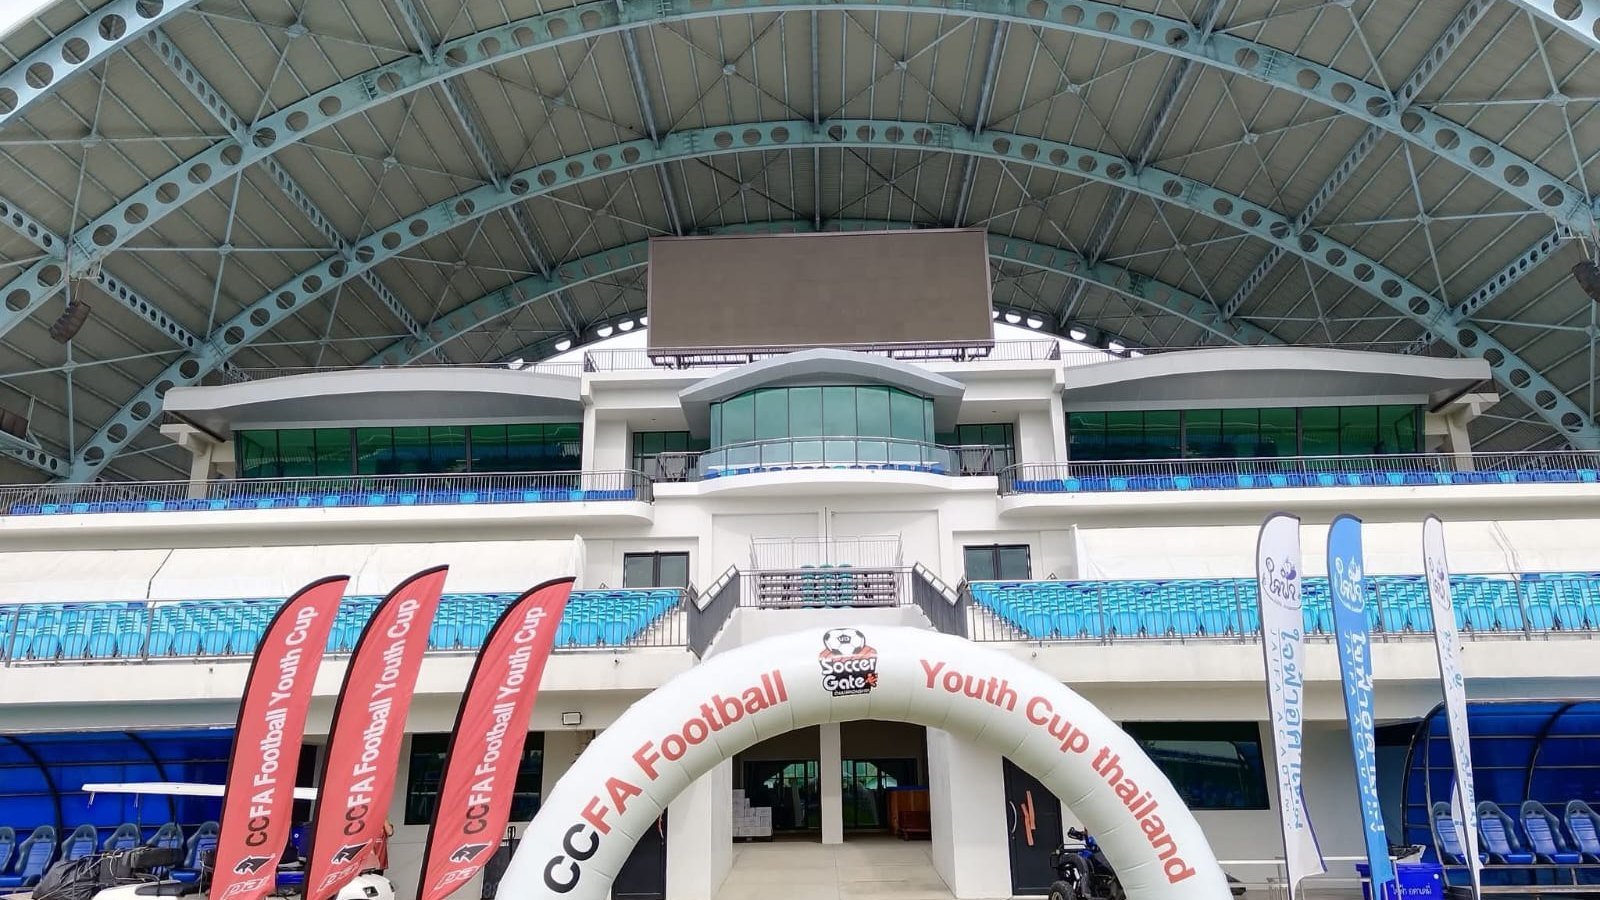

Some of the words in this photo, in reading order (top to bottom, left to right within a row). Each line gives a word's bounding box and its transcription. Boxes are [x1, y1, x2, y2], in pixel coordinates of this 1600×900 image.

[286, 605, 319, 647] Cup
[388, 598, 419, 639] Cup
[514, 606, 547, 643] Cup
[269, 646, 302, 702] Youth
[374, 641, 405, 697] Youth
[498, 644, 532, 699] Youth
[821, 657, 877, 676] Soccer
[823, 674, 866, 692] Gate
[254, 706, 288, 786] Football
[354, 699, 391, 777] Football
[476, 700, 515, 774] Football
[543, 777, 642, 893] CCFA
[632, 670, 788, 781] Football
[920, 659, 1018, 711] Youth
[1025, 696, 1089, 753] Cup
[1091, 747, 1196, 884] thailand
[245, 788, 275, 847] CCFA
[344, 776, 374, 837] CCFA
[463, 774, 494, 835] CCFA
